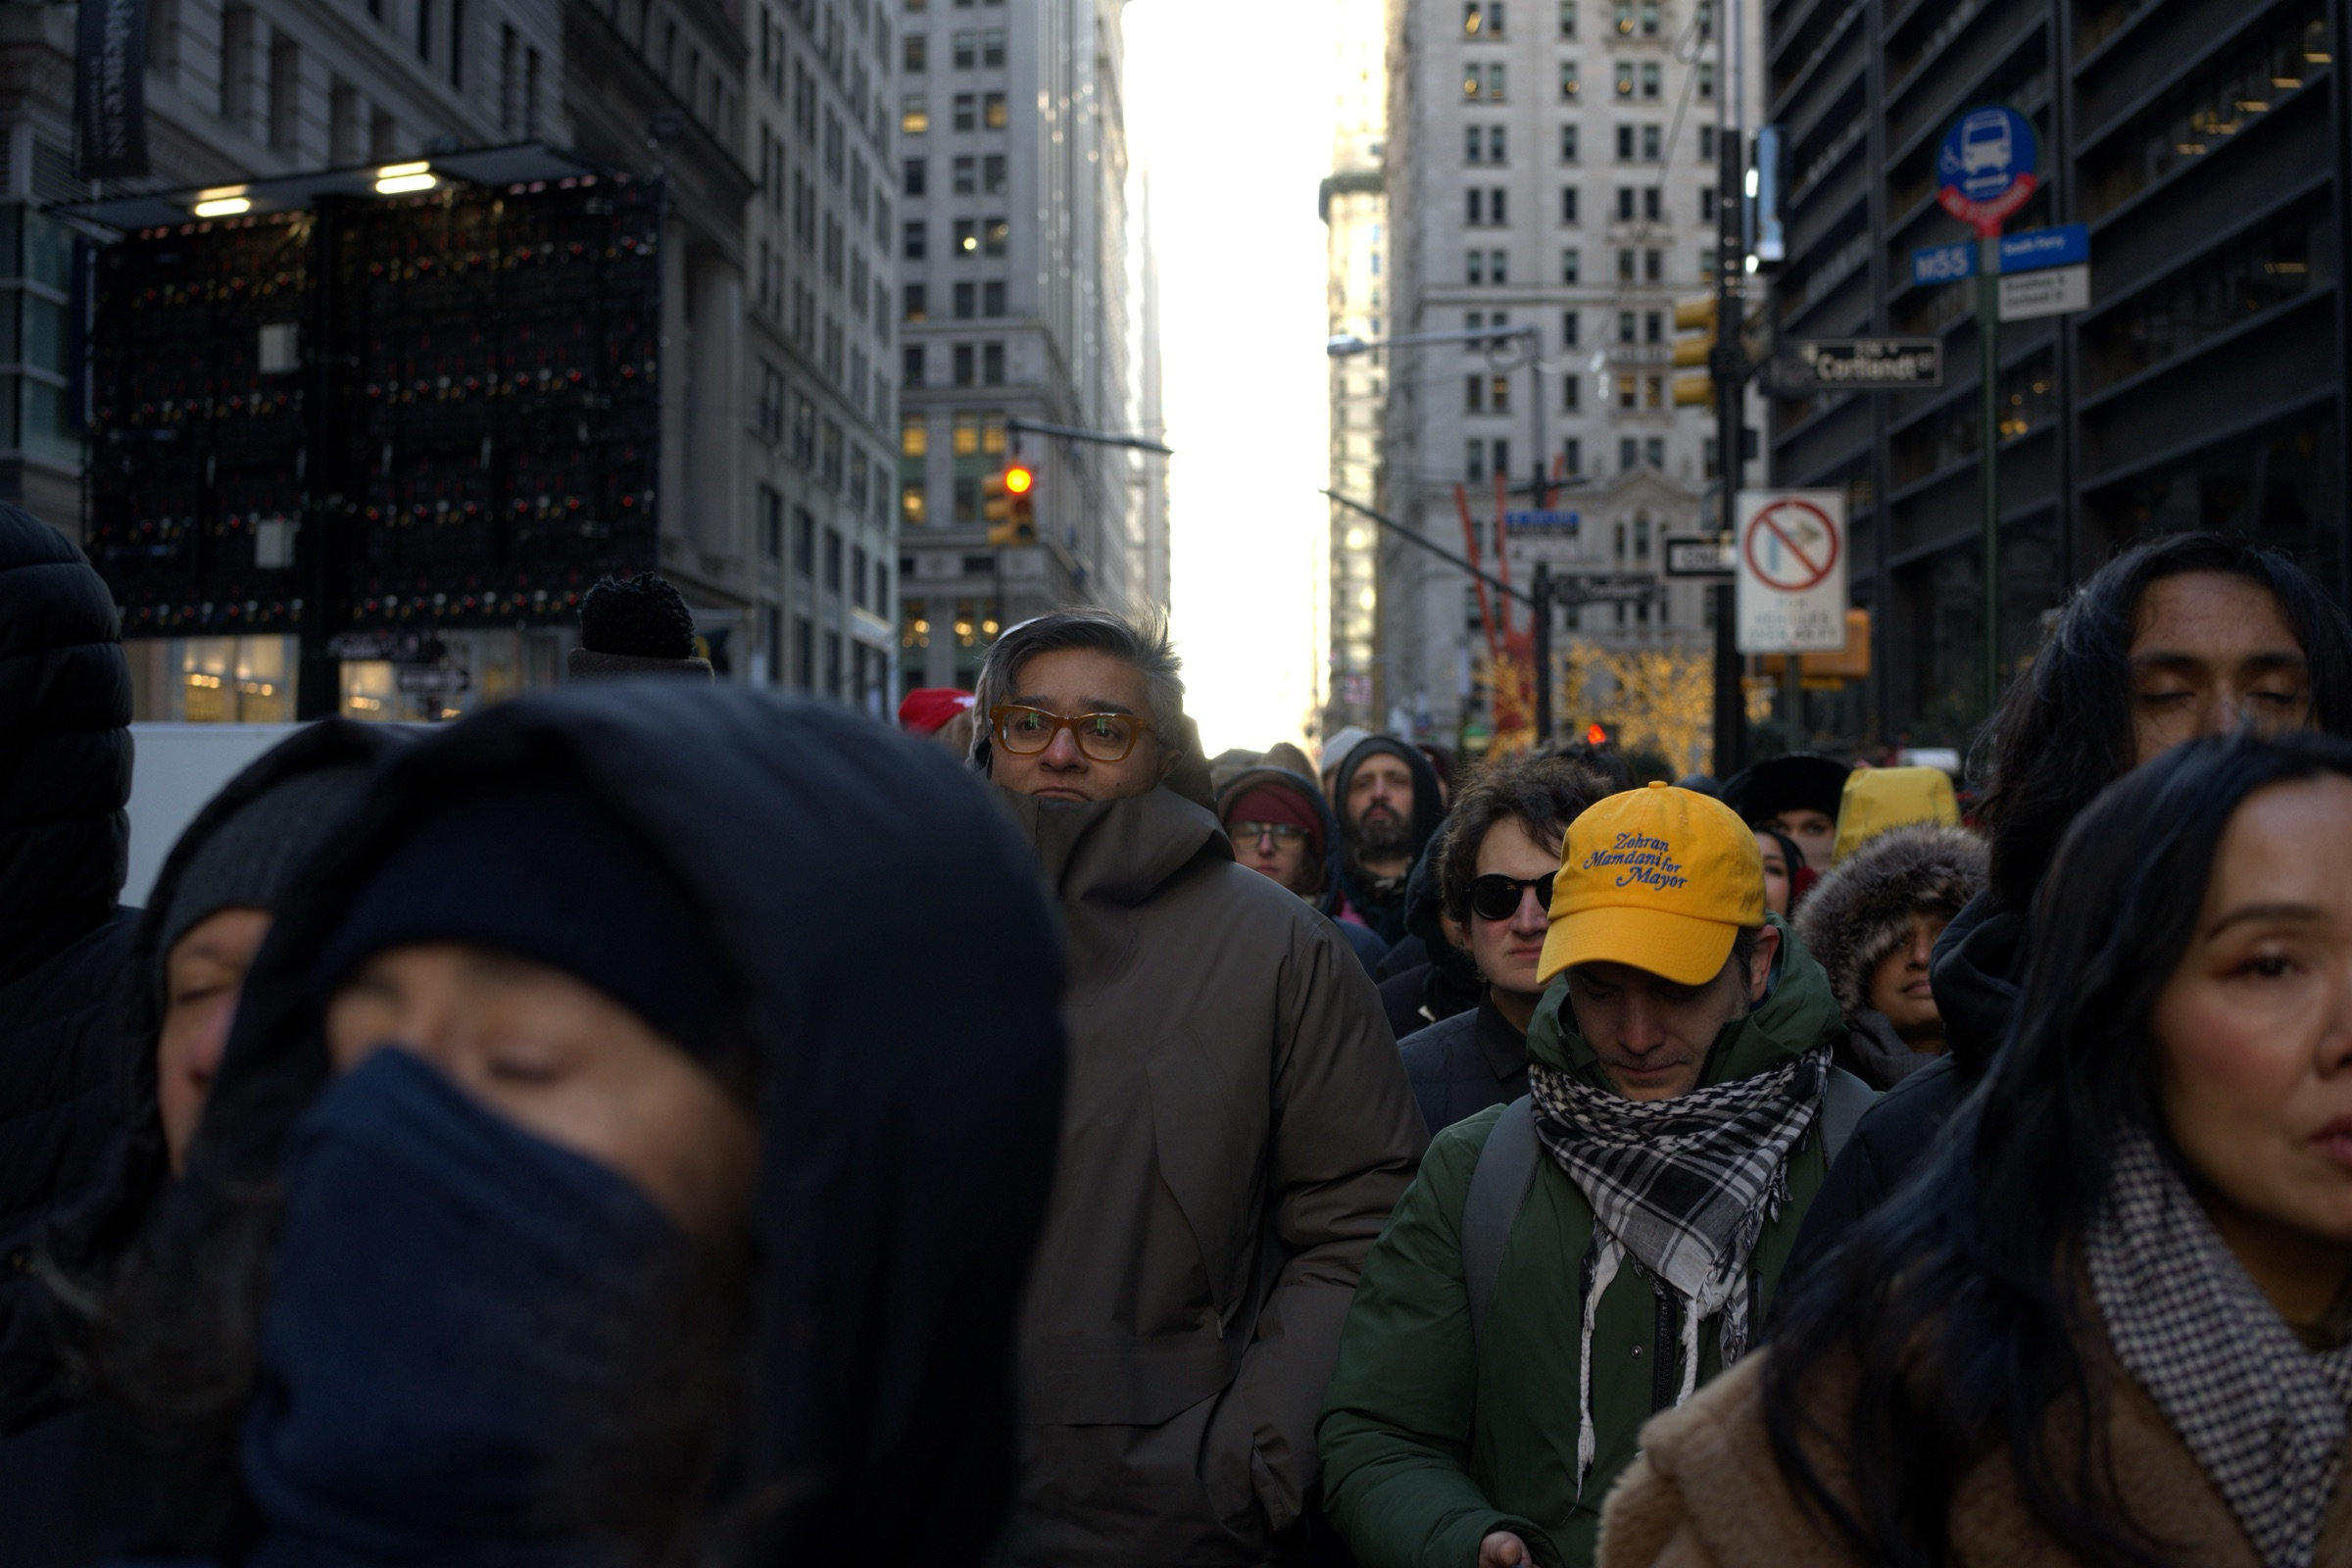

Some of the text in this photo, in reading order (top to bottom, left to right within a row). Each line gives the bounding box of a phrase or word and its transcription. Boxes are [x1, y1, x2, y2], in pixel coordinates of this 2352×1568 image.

[1817, 353, 1917, 381] Cortlandt
[1614, 832, 1669, 853] Zohran
[1584, 850, 1683, 873] Mamdani for
[1616, 866, 1688, 891] Mayor
